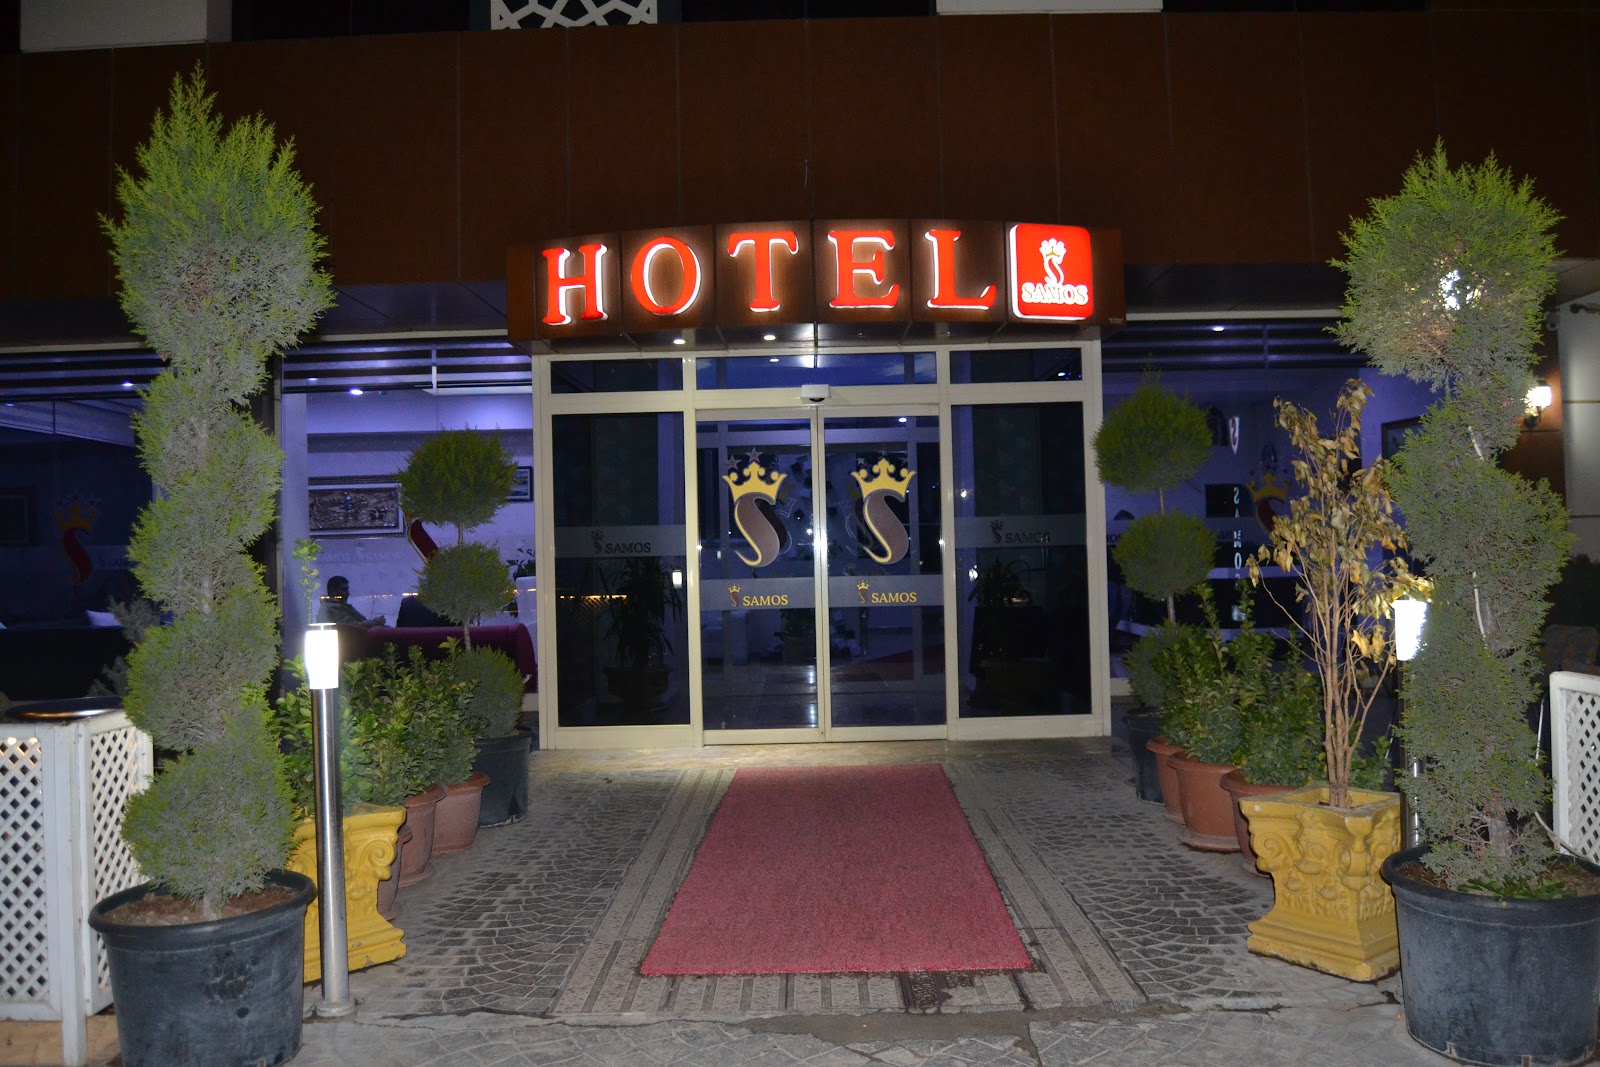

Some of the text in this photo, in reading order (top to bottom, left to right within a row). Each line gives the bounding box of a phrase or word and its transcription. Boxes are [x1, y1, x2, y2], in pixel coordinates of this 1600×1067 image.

[541, 229, 997, 325] HOTEL
[1021, 282, 1089, 306] SAMOS
[605, 542, 652, 554] SAMOS
[743, 594, 789, 607] SAMOS
[871, 592, 917, 604] SAMOS
